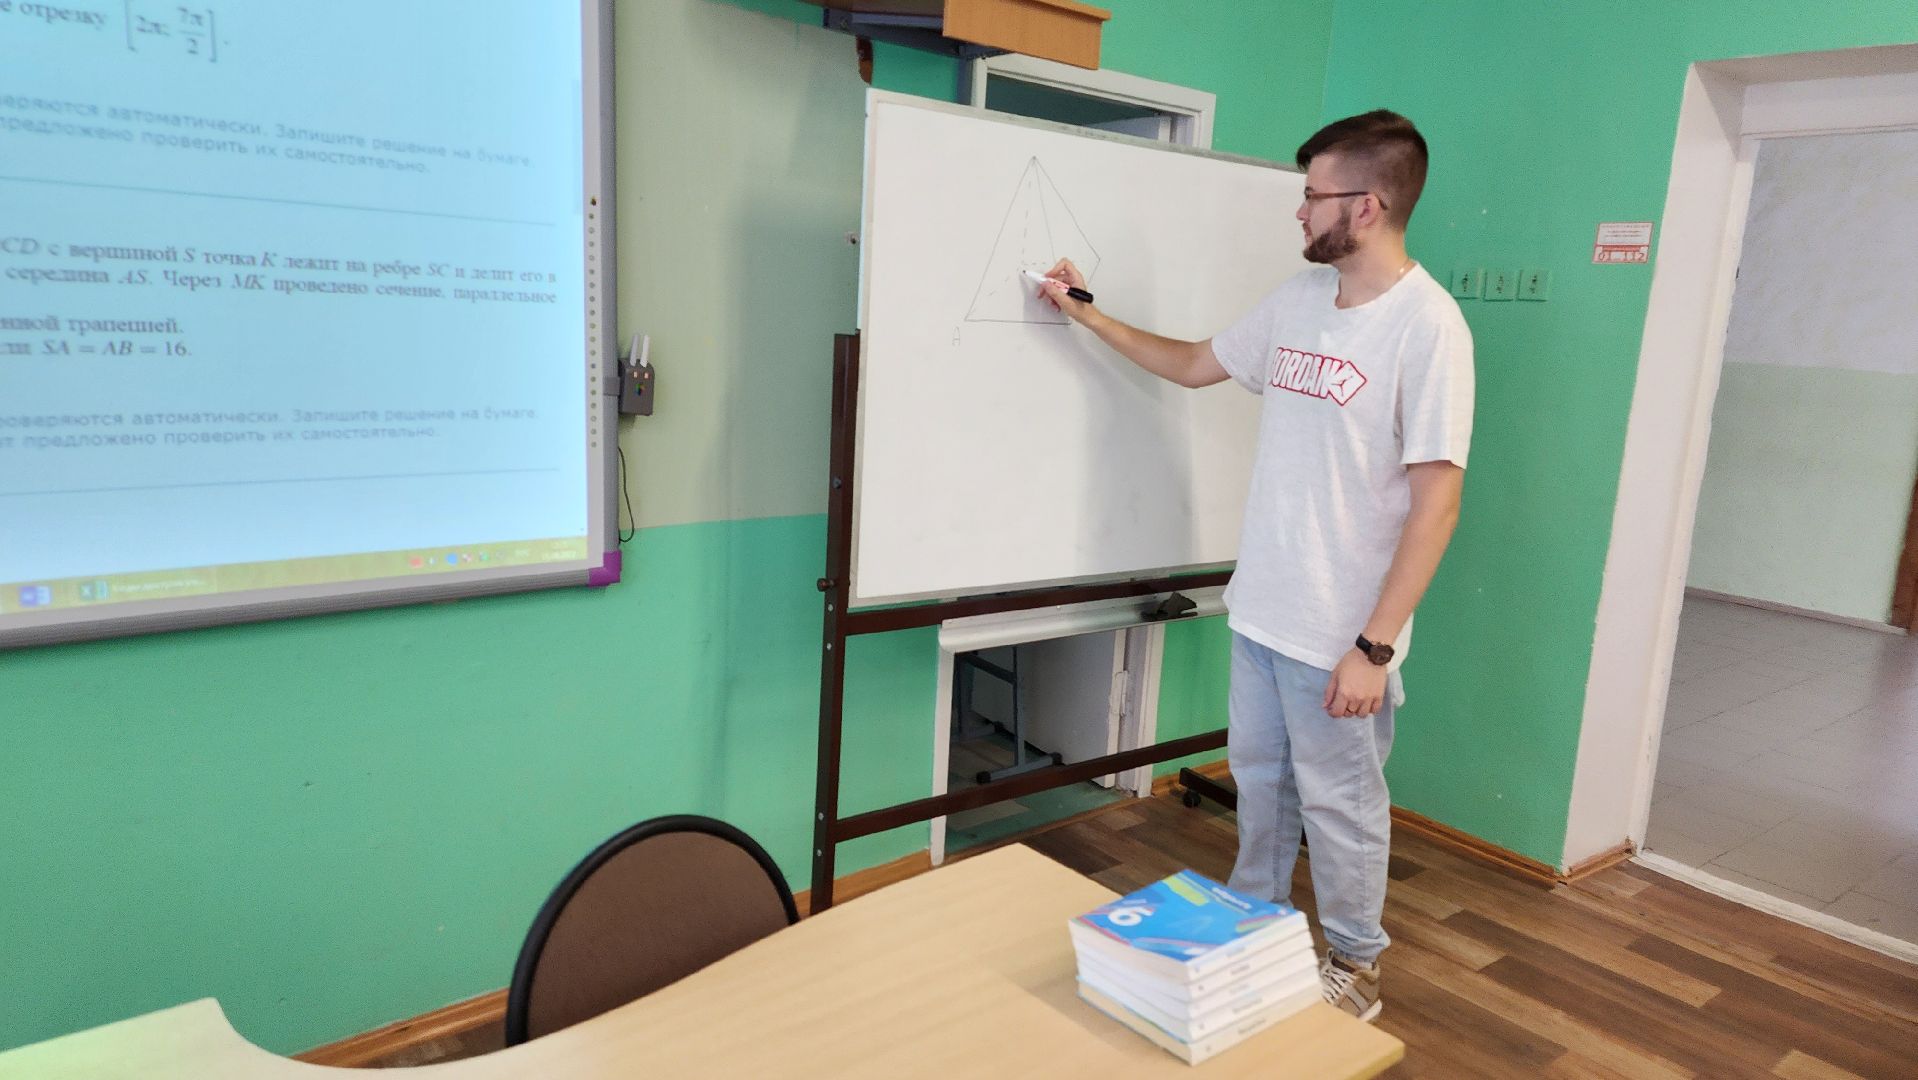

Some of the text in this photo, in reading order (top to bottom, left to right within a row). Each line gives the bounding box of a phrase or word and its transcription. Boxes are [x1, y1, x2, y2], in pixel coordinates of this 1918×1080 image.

[19, 2, 107, 31] отрезку
[107, 104, 269, 136] автоматически.
[274, 123, 366, 148] Запишите
[371, 136, 448, 158] решение
[452, 149, 472, 161] на
[141, 129, 250, 155] проверить
[255, 143, 278, 158] их
[283, 145, 432, 174] самостоятельно.
[47, 243, 60, 257] с
[68, 243, 178, 264] вершиной
[182, 246, 197, 263] S
[203, 250, 258, 267] точка
[260, 251, 279, 268] K
[283, 255, 340, 273] лежит
[346, 261, 367, 274] на
[373, 260, 421, 280] ребре
[426, 262, 451, 278] SC
[455, 267, 467, 279] и
[470, 268, 515, 283] делит
[519, 272, 544, 284] его
[547, 273, 558, 284] в
[5, 266, 110, 285] середина
[117, 268, 153, 286] AS.
[162, 268, 223, 293] Через
[231, 273, 267, 292] MK
[273, 277, 369, 297] проведено
[453, 286, 558, 305] параллельное
[67, 317, 184, 337] трапецией.
[41, 338, 71, 357] SA
[102, 339, 133, 357] AB
[164, 339, 193, 357] 16.
[131, 410, 284, 427] автоматически.
[292, 407, 380, 424] Запишите
[384, 408, 456, 424] решение
[461, 408, 480, 421] на
[484, 404, 540, 421] бумаге.
[22, 431, 157, 450] предложено
[163, 428, 267, 446] проверить
[272, 428, 295, 442] их
[300, 424, 441, 442] самостоятельно.
